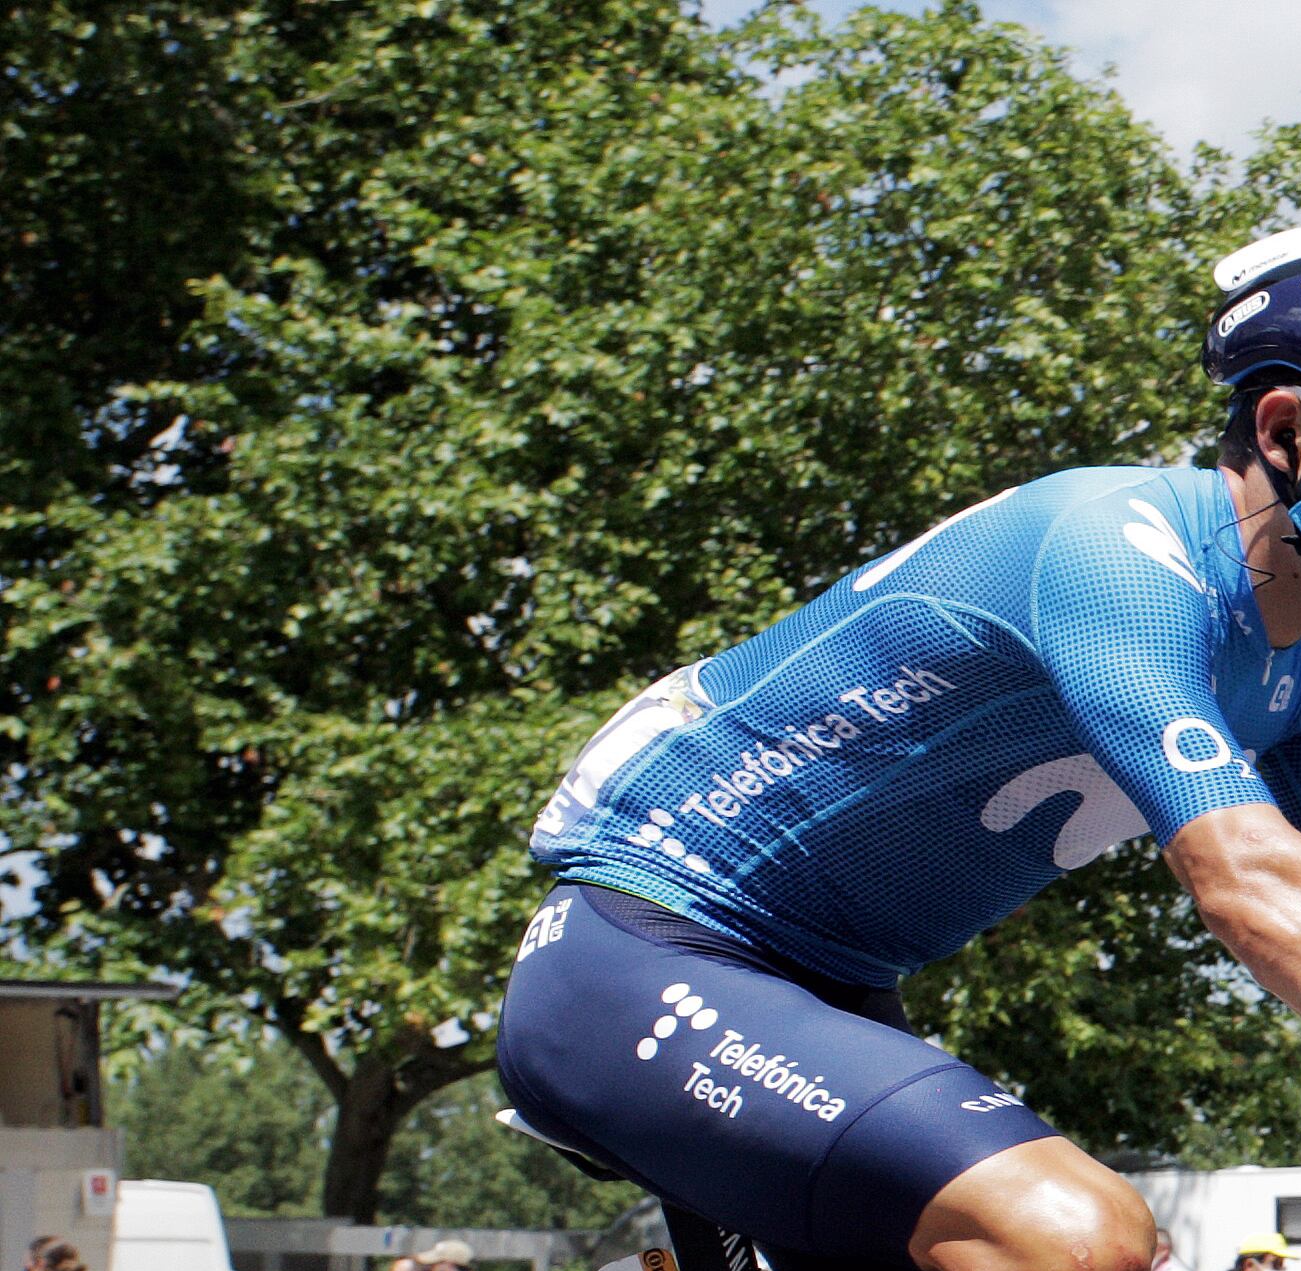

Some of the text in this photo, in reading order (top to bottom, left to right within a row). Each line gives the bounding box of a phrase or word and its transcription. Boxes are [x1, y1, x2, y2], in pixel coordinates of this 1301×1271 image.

[682, 665, 956, 829] Telefónica Tech
[683, 1061, 745, 1118] Tech
[709, 1029, 846, 1122] Telefónica
